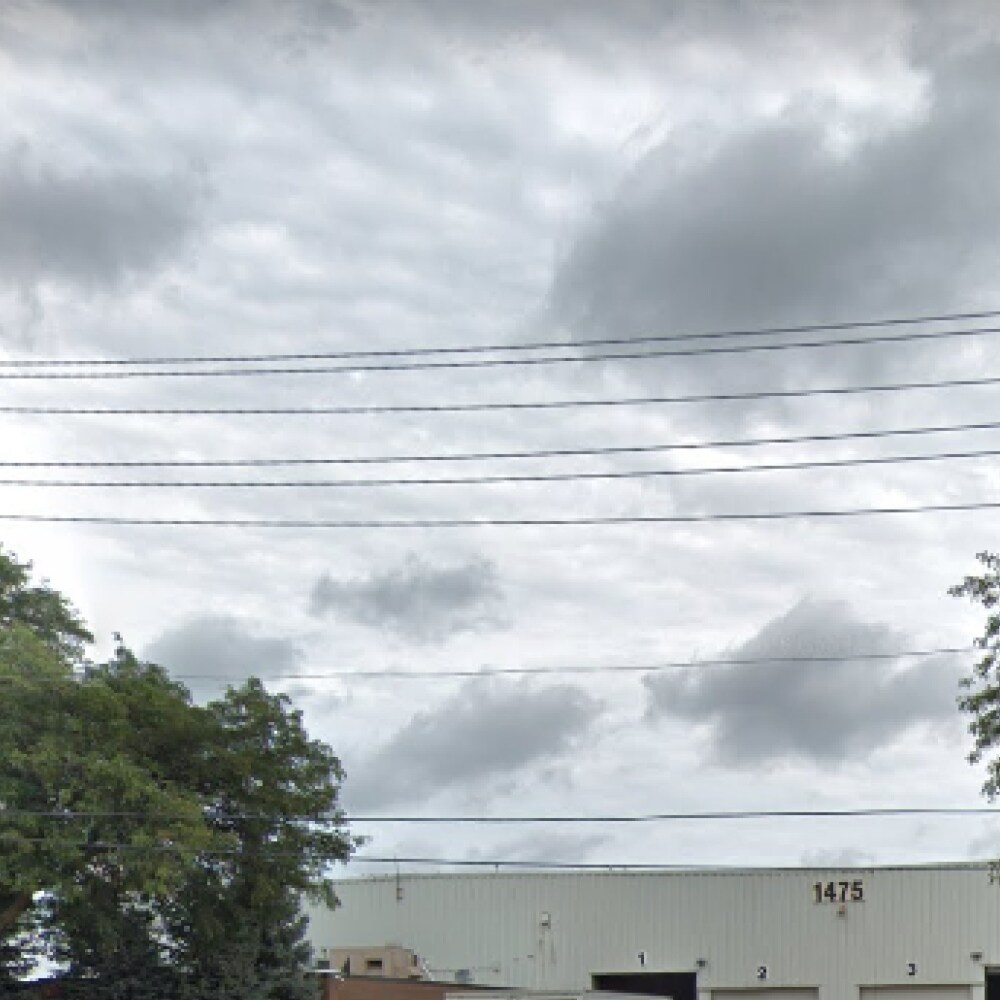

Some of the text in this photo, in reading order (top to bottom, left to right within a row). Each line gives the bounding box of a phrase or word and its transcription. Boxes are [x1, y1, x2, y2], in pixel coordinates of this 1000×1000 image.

[814, 880, 865, 902] 1475
[637, 952, 645, 966] 1
[757, 966, 767, 979] 2
[908, 963, 916, 976] 3
